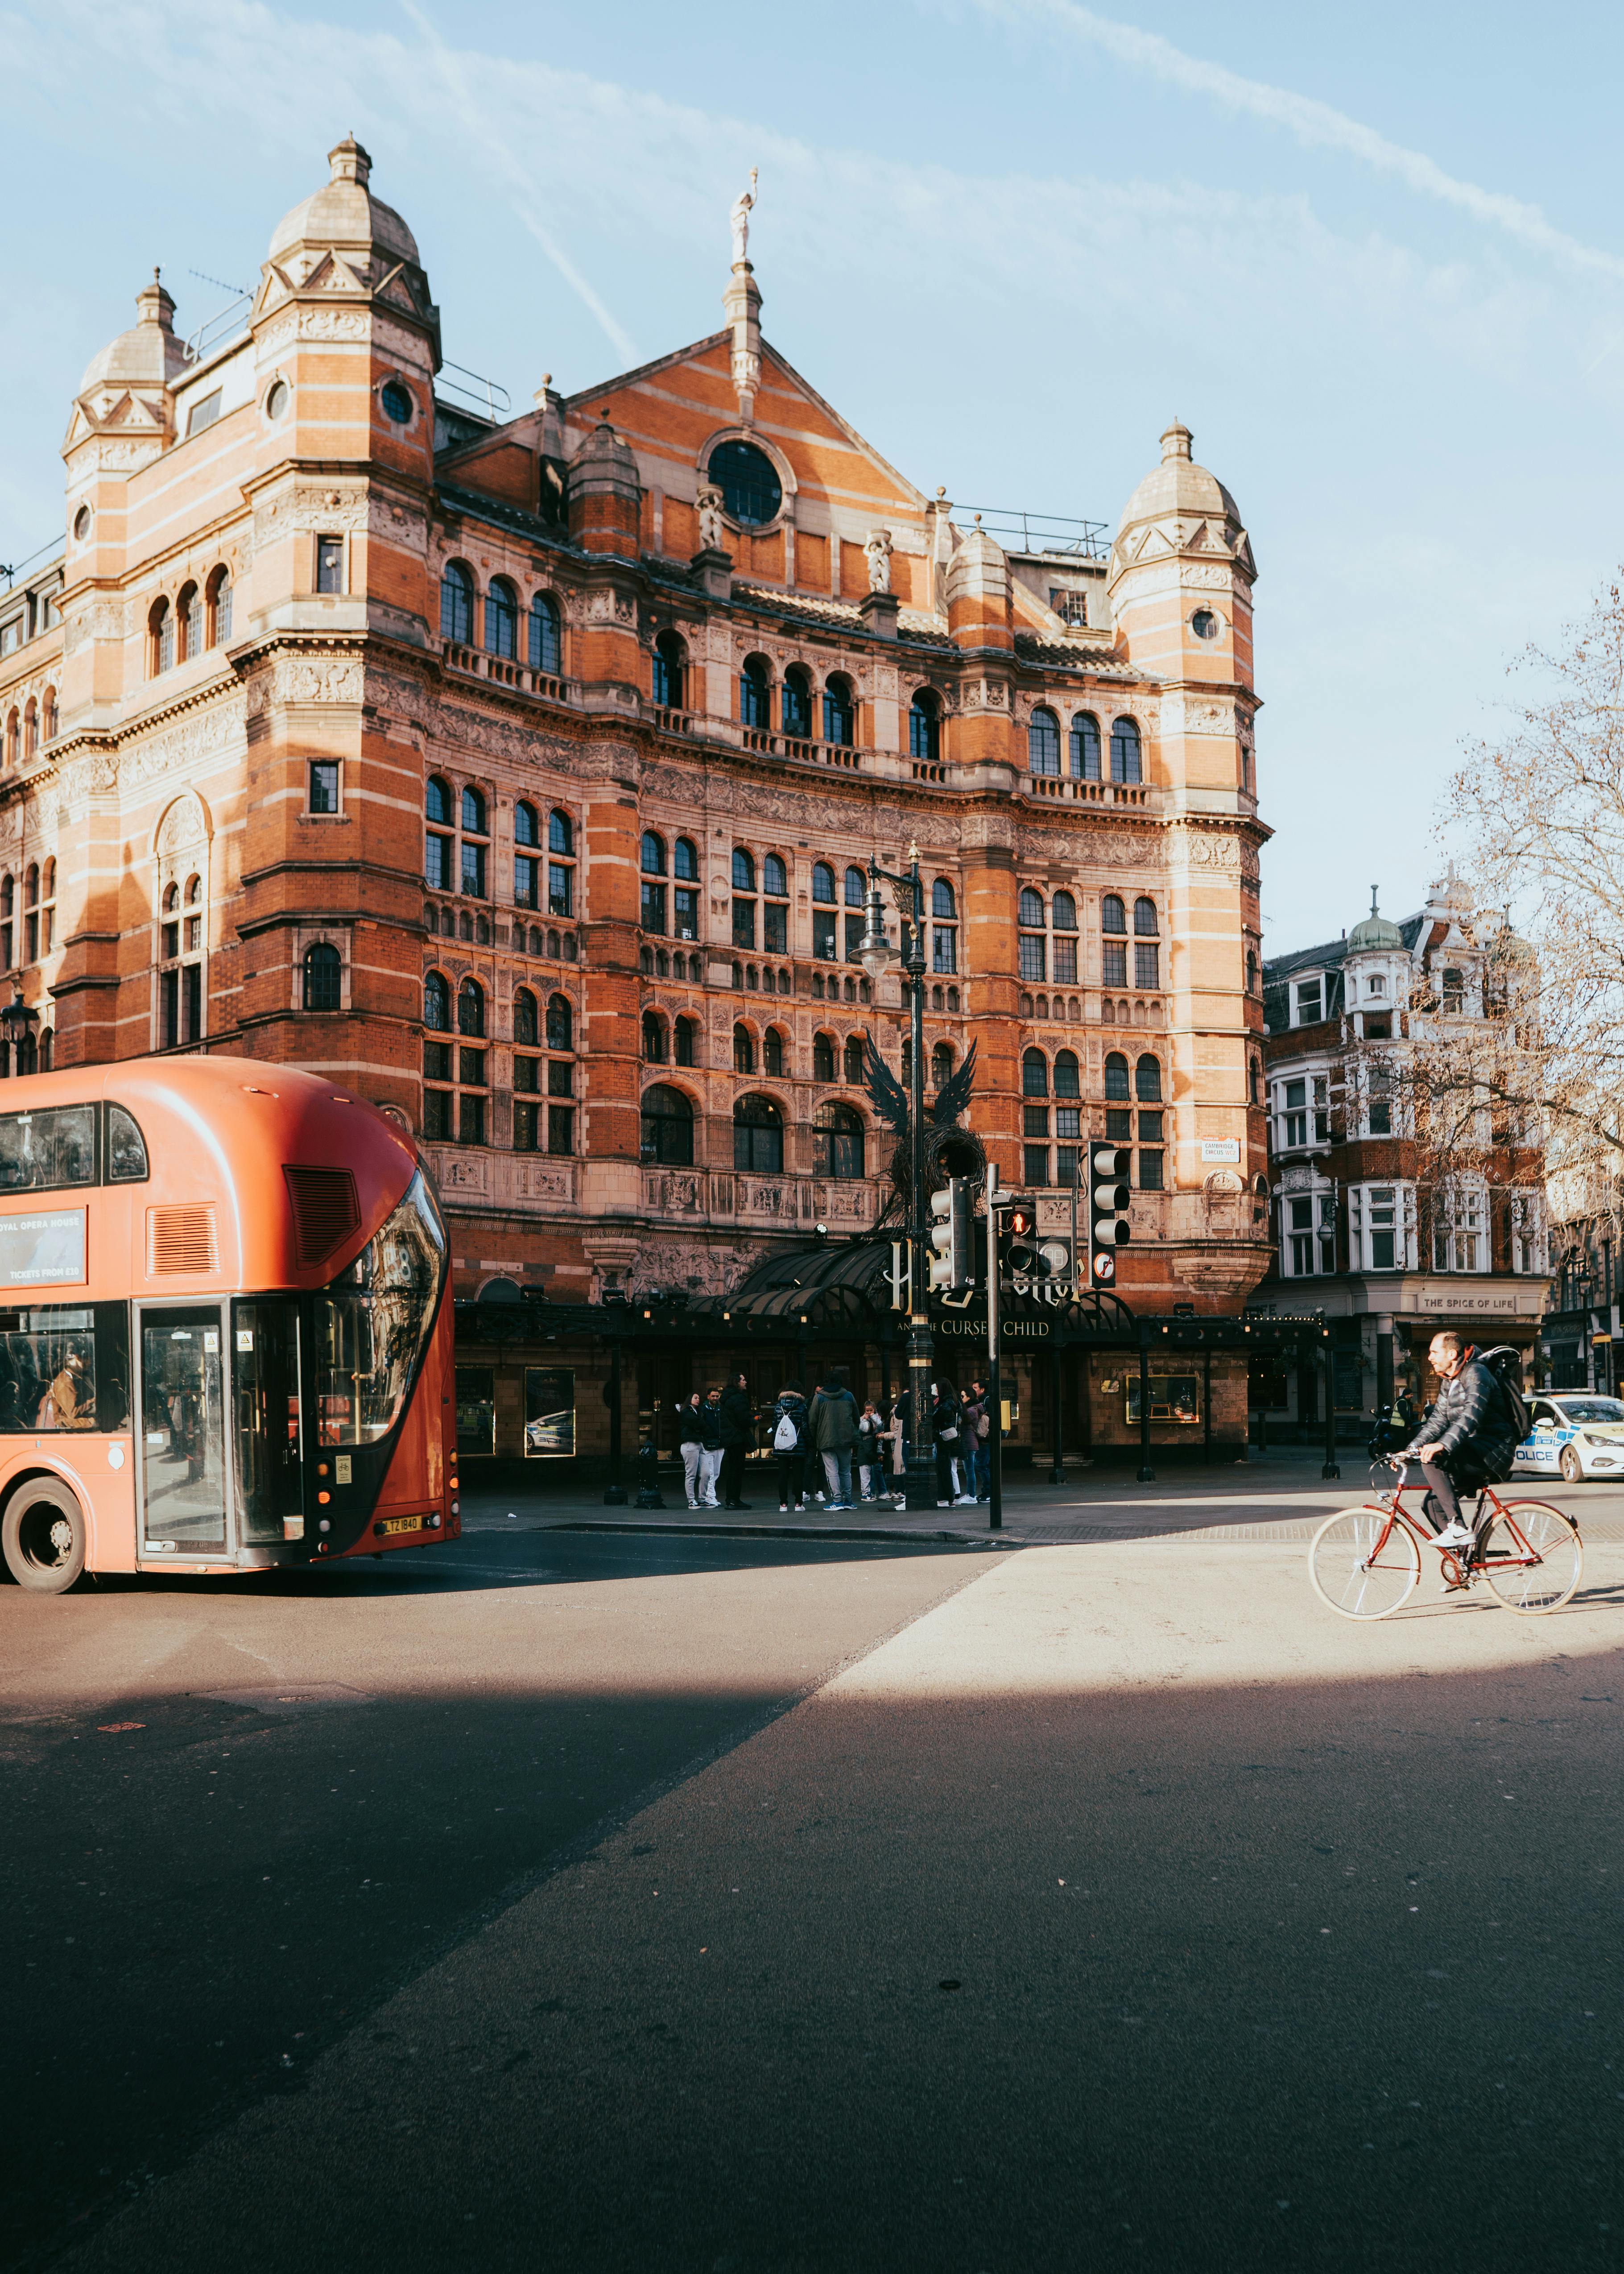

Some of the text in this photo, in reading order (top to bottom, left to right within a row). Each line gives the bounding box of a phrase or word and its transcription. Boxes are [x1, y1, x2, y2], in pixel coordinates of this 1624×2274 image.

[0, 1217, 79, 1232] OYAL OPERA HOUSE
[10, 1267, 79, 1280] TICKETS FROM £10
[1424, 1299, 1513, 1308] THE SPICE OF LIFE
[897, 1322, 910, 1331] AN
[942, 1320, 988, 1336] CURSE
[1003, 1321, 1049, 1336] CHILD
[1516, 1450, 1554, 1461] OLICE
[385, 1518, 417, 1533] LTZ 1840
